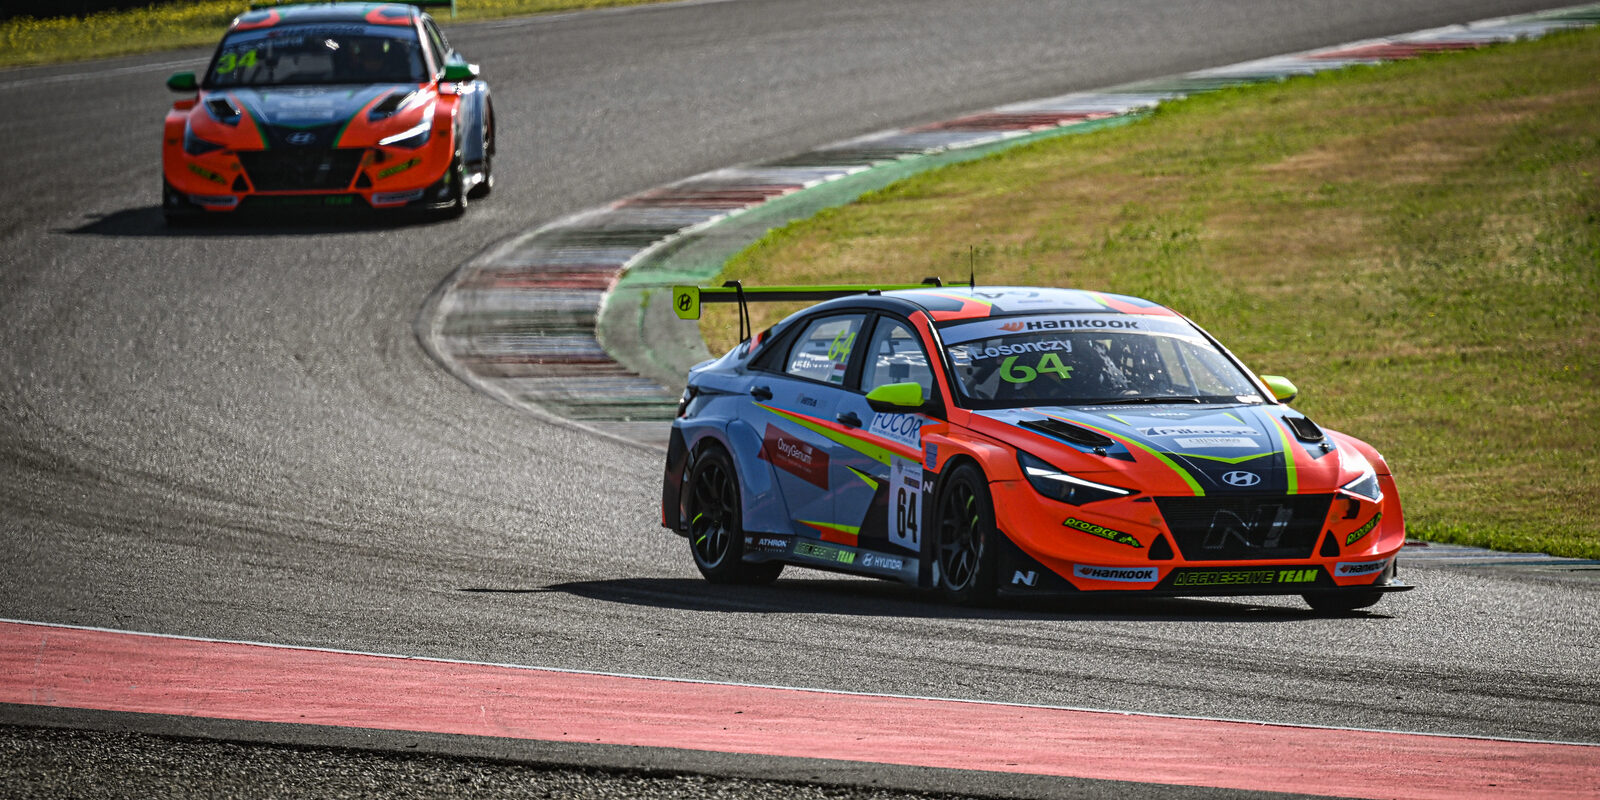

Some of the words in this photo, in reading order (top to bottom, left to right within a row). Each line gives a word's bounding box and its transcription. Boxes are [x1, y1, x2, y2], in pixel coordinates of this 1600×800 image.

[216, 49, 258, 74] 34
[828, 329, 857, 363] 64
[1000, 352, 1074, 384] 64
[873, 411, 923, 439] FOCOR
[896, 486, 918, 544] 64
[1063, 516, 1118, 539] prorace
[835, 549, 857, 565] TEAM
[873, 555, 904, 571] HYUNDAI
[1174, 570, 1276, 586] AGGRESSIVE
[1277, 568, 1319, 583] TEAM
